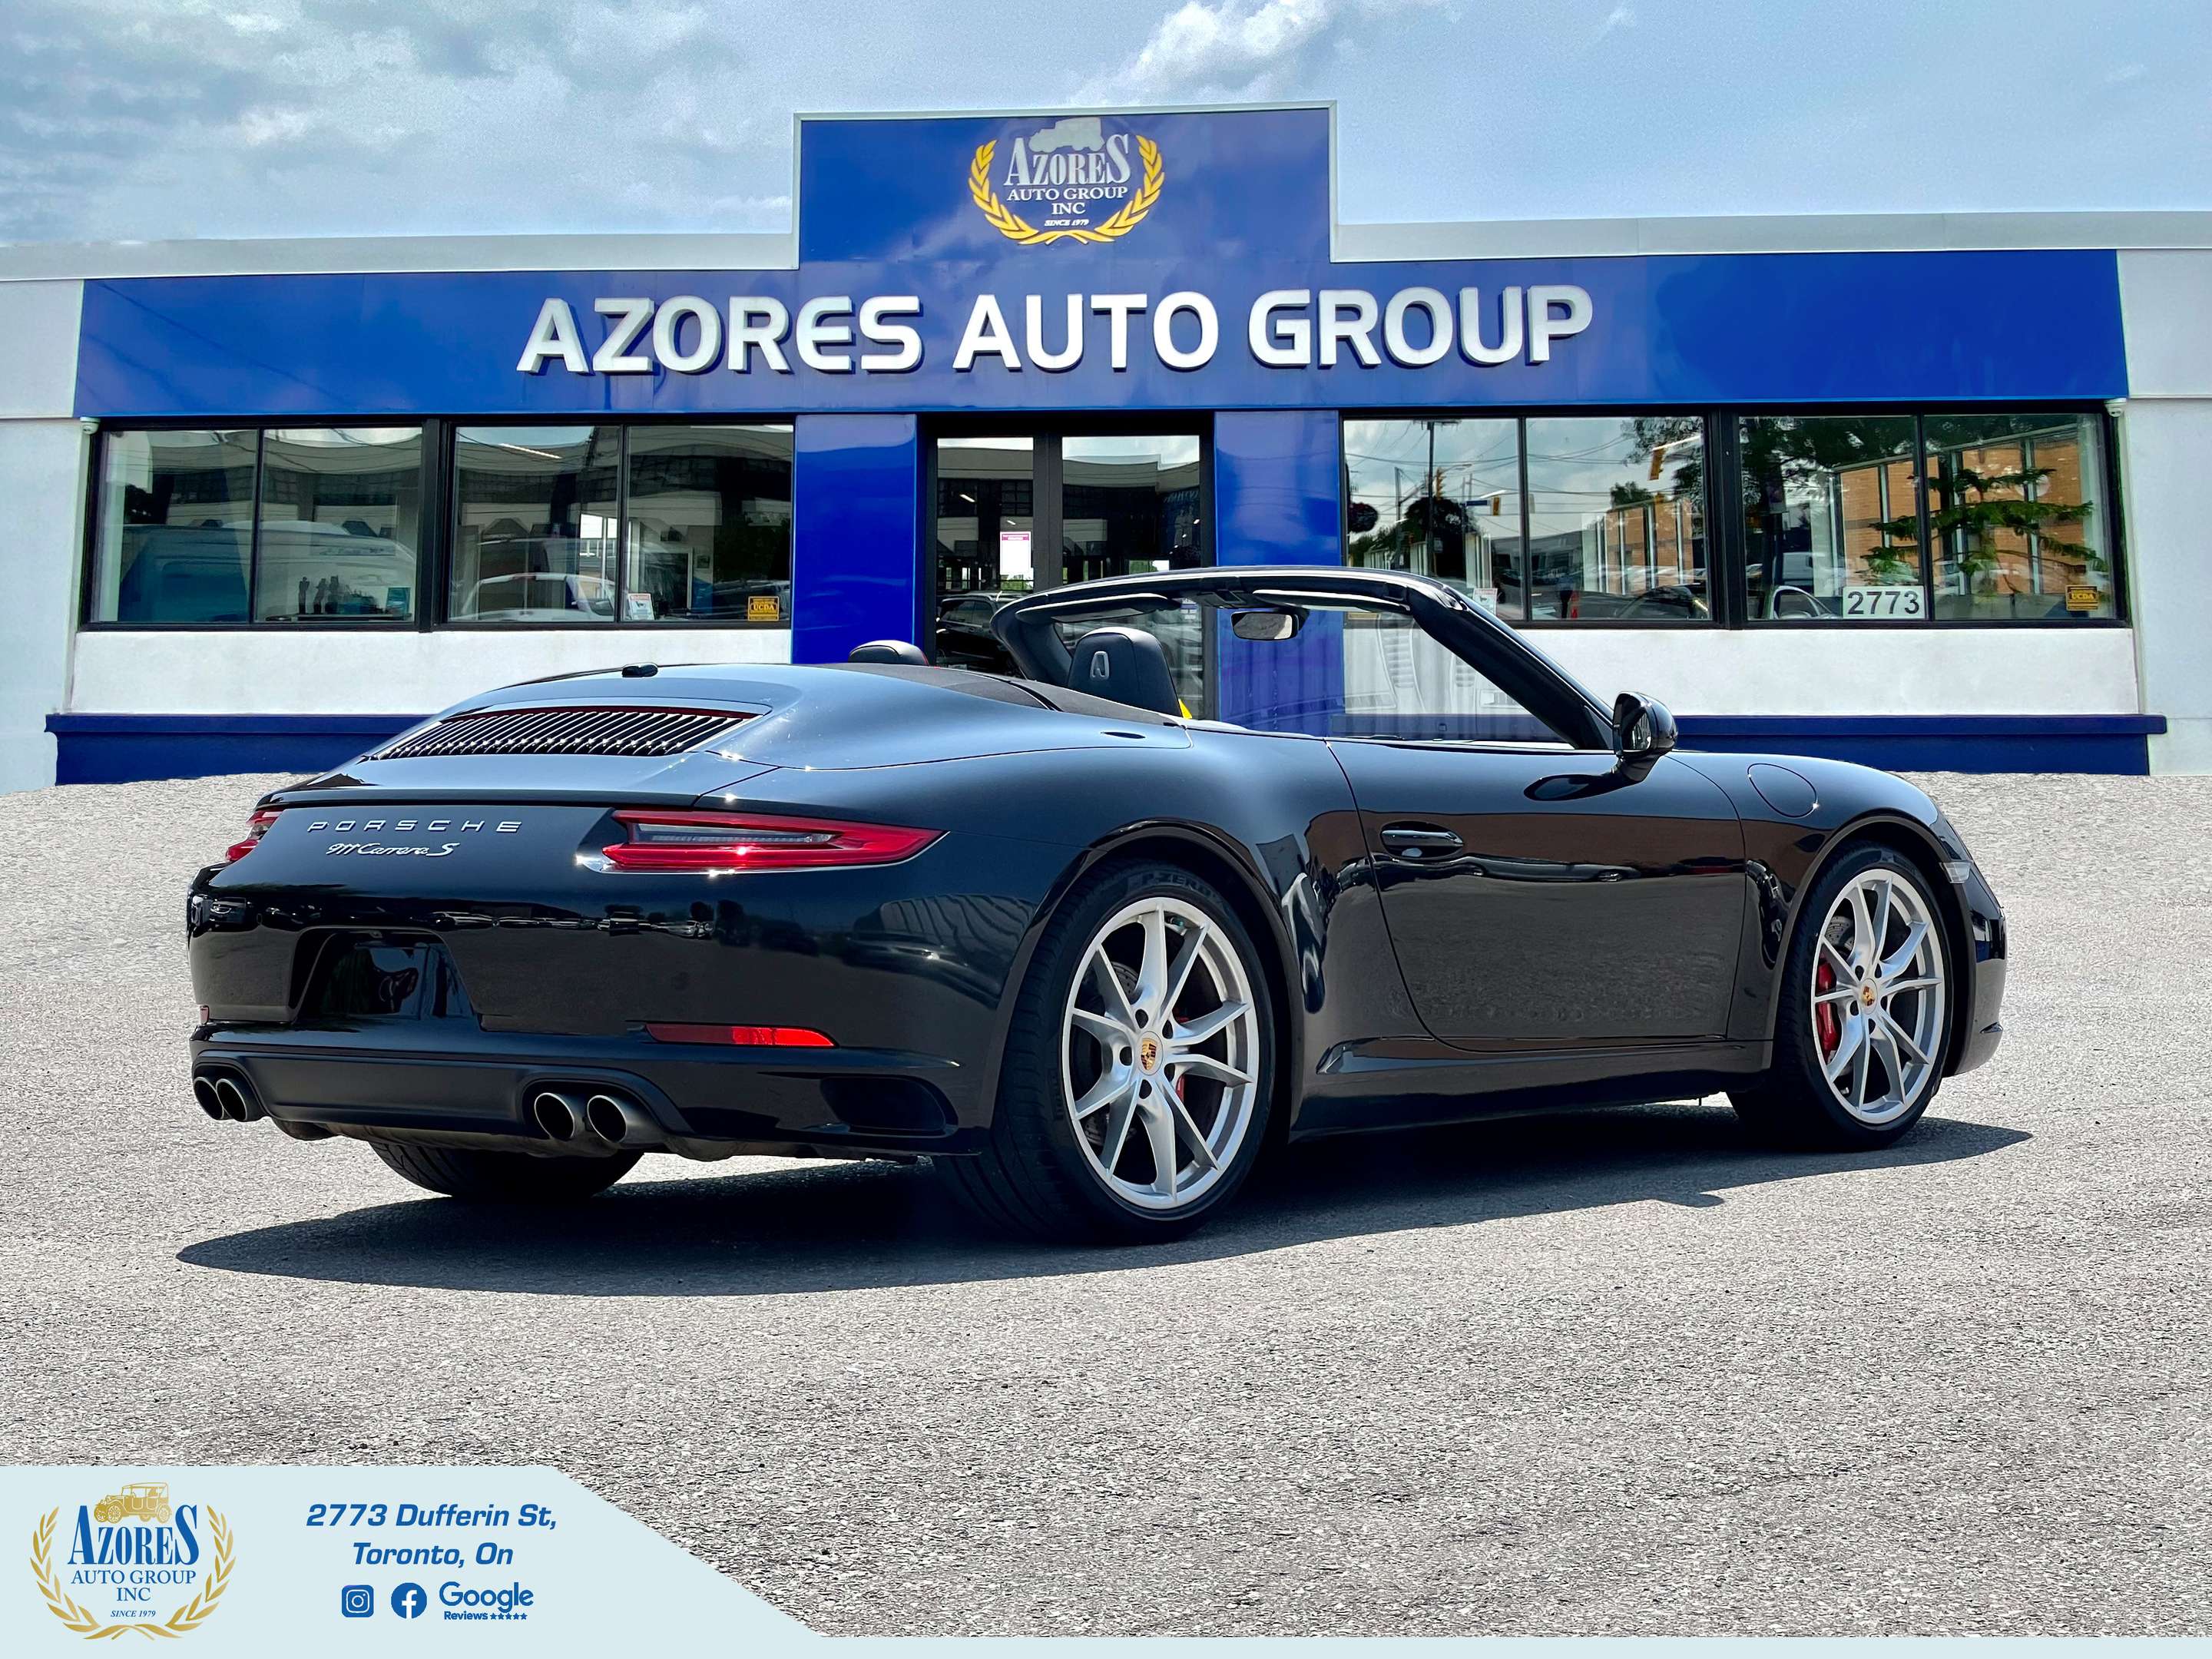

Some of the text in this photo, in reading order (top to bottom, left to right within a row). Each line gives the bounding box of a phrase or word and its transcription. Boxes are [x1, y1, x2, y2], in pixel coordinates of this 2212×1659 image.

[1004, 134, 1131, 186] AZORES
[1007, 187, 1128, 201] AUTO GROUP
[1051, 203, 1085, 214] INC
[517, 285, 1594, 375] AZORES AUTO GROUP
[1848, 591, 1919, 614] 2773
[307, 820, 522, 832] PORSCHE
